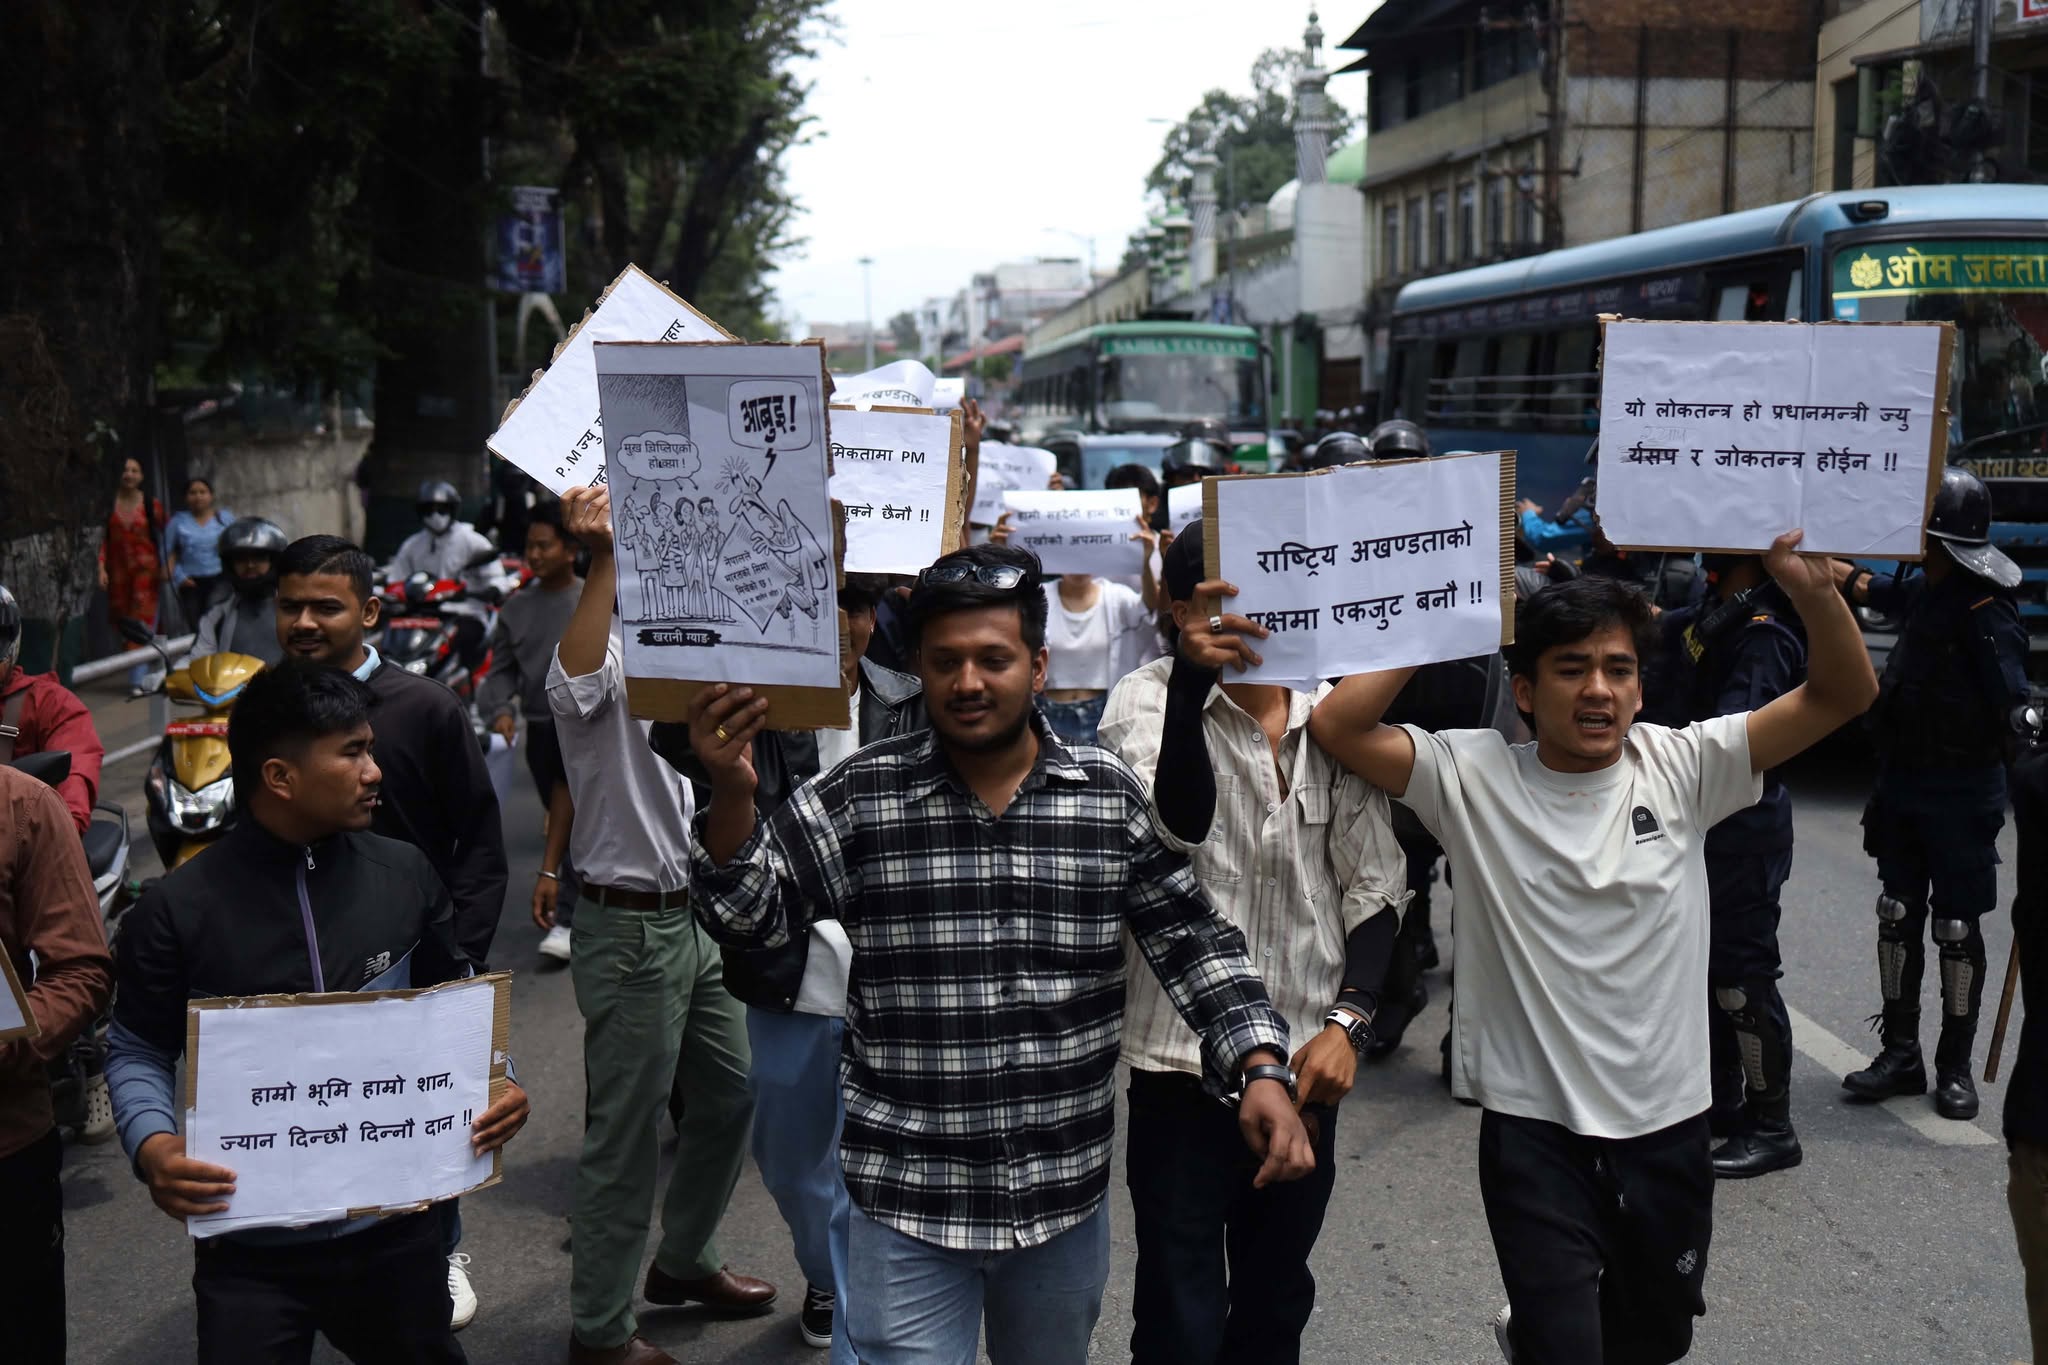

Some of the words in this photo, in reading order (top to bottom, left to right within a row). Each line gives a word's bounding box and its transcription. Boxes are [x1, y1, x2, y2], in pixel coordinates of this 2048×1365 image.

[1887, 246, 1957, 287] ओम
[1962, 254, 2048, 285] जनता
[1625, 397, 1646, 418] यो
[1655, 398, 1733, 419] लोकतन्त्र
[1743, 399, 1762, 421] हो
[1772, 401, 1870, 423] प्रधानमन्त्री
[1879, 407, 1911, 432] ज्यु
[623, 443, 642, 457] मुख
[831, 442, 894, 463] मिकतामा
[901, 451, 925, 464] PM
[1690, 449, 1704, 467] र
[1714, 444, 1805, 469] जोकतन्त्र
[1816, 446, 1871, 474] होईन
[1884, 452, 1897, 472] !!
[920, 509, 930, 522] !!
[1257, 541, 1339, 577] राष्ट्रिय
[1350, 520, 1473, 563] अखण्डताको
[1331, 594, 1405, 631] एकजुट
[1415, 579, 1458, 611] बनौ
[1470, 580, 1482, 605] !!
[652, 629, 682, 643] खरानी
[251, 1080, 298, 1107] हाम्रो
[308, 1077, 352, 1107] भूमि
[362, 1074, 406, 1100] हाम्रो
[417, 1072, 454, 1093] शान,
[220, 1132, 277, 1151] ज्यान
[288, 1122, 349, 1148] दिन्छौ
[359, 1117, 415, 1143] दिन्नौ
[424, 1114, 455, 1137] दान
[462, 1108, 473, 1127] !!
